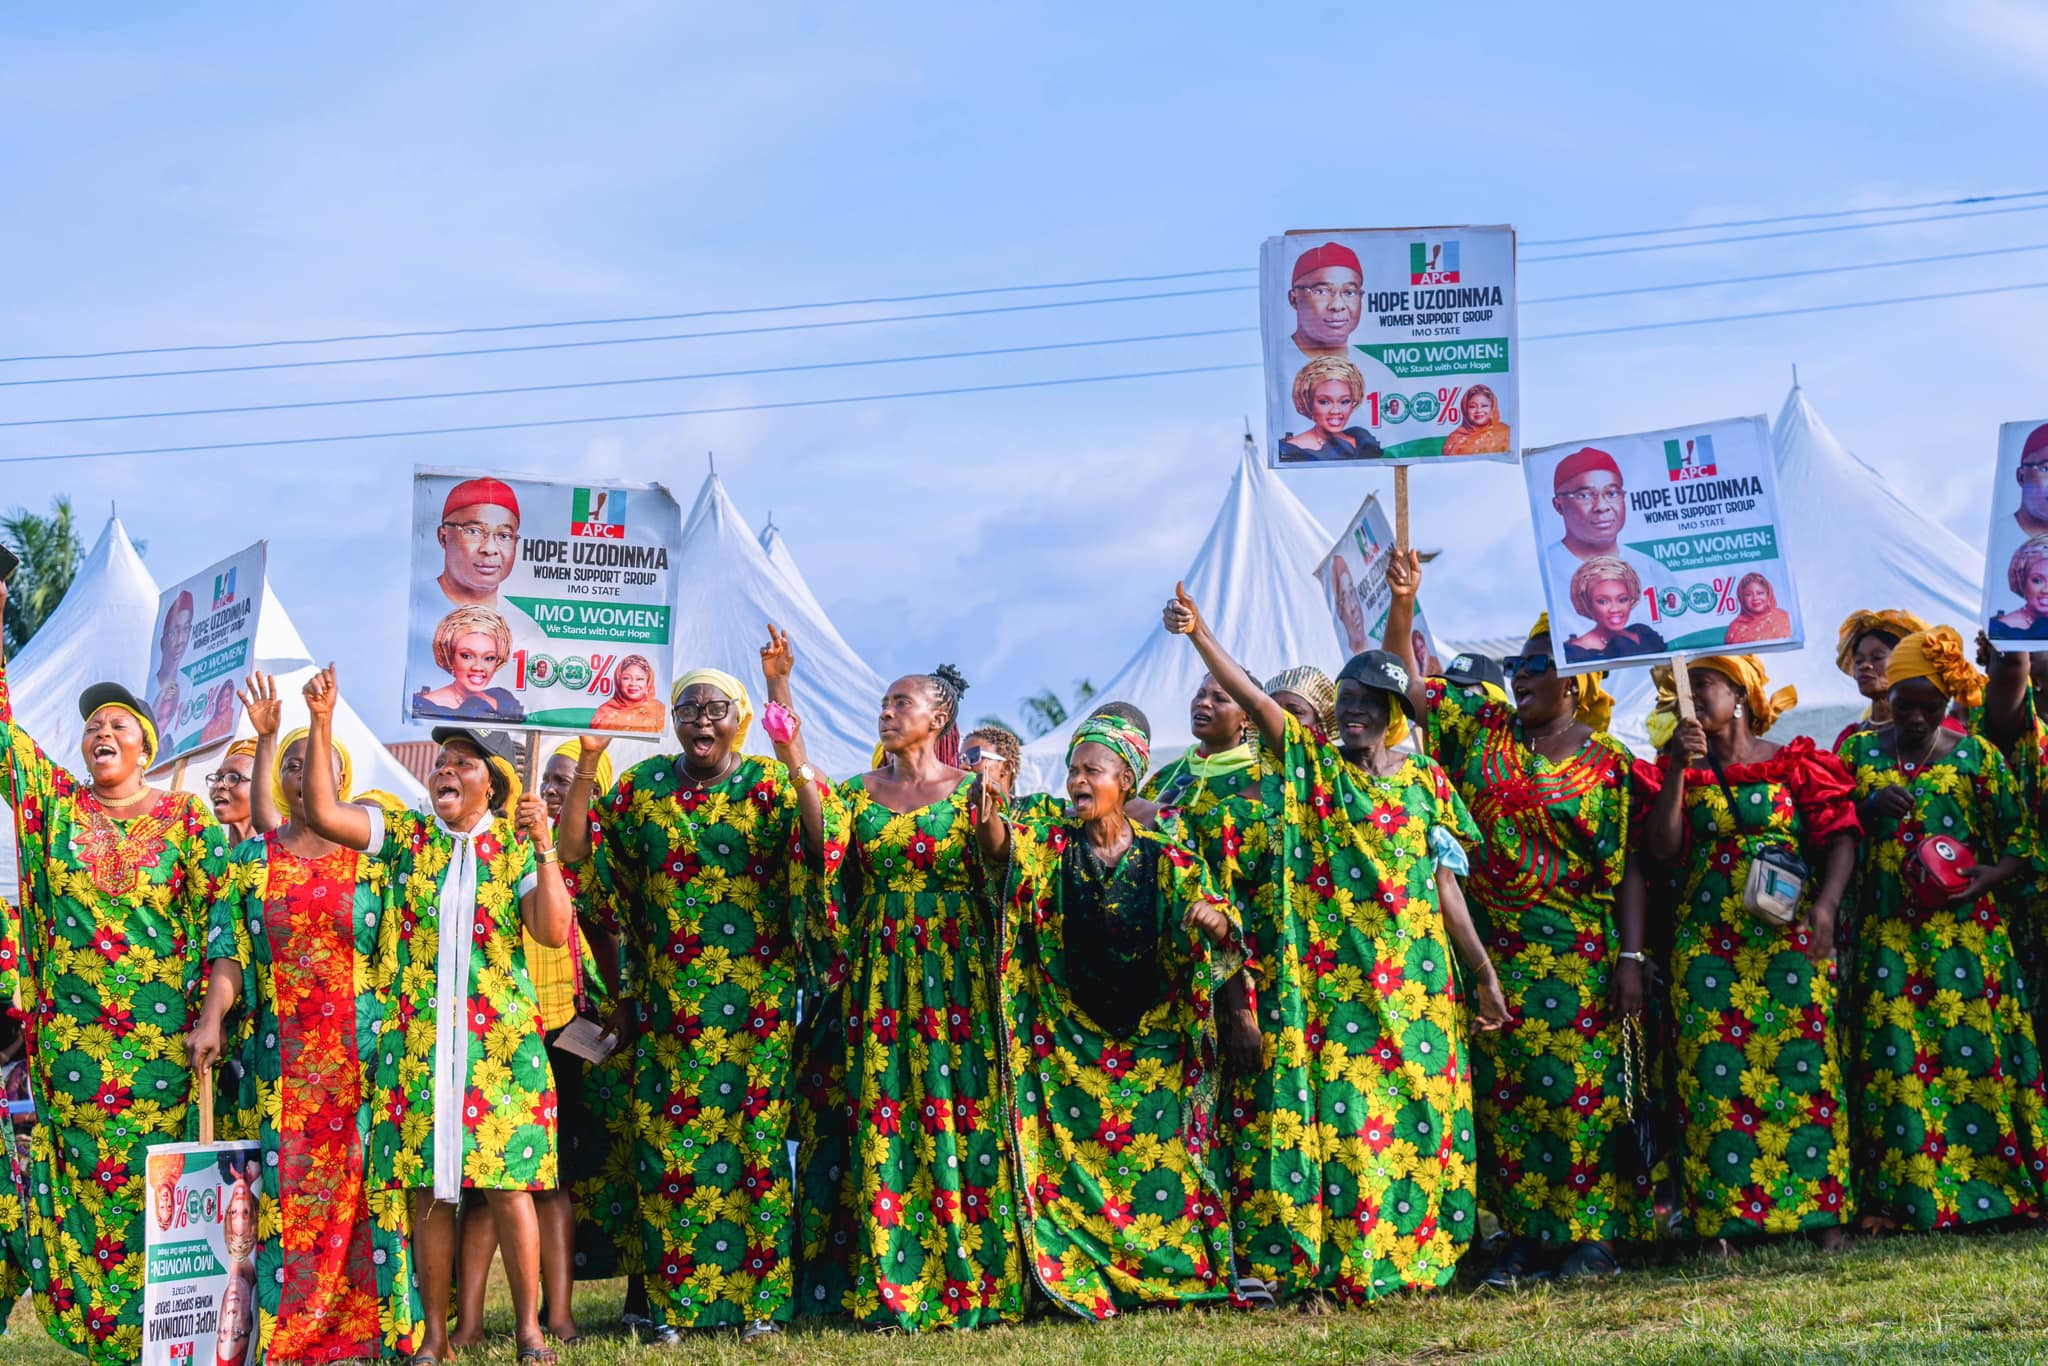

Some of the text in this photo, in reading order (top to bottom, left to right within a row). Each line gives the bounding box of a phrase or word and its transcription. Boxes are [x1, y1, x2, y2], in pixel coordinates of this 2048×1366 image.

[1420, 272, 1452, 285] APC
[1368, 286, 1503, 312] HOPE UZODINMA
[1379, 309, 1493, 327] WOMEN SUPPORT GROUP
[1412, 327, 1460, 336] IMO STATE
[1383, 343, 1503, 364] IMO WOMEN:
[1395, 361, 1491, 374] We Stand with Our Hope
[1367, 387, 1461, 427] 100%
[1679, 466, 1709, 480] APC
[1630, 476, 1763, 511] HOPE UZODINMA
[1645, 499, 1755, 524] WOMEN SUPPORT GROUP
[581, 523, 614, 537] APC
[1678, 518, 1725, 530] IMO STATE
[522, 539, 668, 570] HOPE UZODINMA
[1653, 532, 1772, 558] IMO WOMEN:
[1667, 559, 1681, 568] We
[1682, 556, 1704, 565] Stand
[1705, 554, 1723, 562] with
[1740, 550, 1761, 560] Hope
[534, 565, 656, 585] WOMEN SUPPORT GROUP
[568, 585, 620, 596] IMO STATE
[1643, 577, 1737, 623] 100%
[534, 605, 665, 628] IMO WOMEN:
[546, 625, 650, 639] We Stand with Our Hope
[513, 649, 616, 696] 100%
[175, 1185, 223, 1229] 100%
[151, 1253, 214, 1276] IMO WOMEN:
[172, 1284, 197, 1296] IMO STATE
[155, 1295, 213, 1315] WOMEN SUPPORT GROUP
[149, 1311, 217, 1342] HOPE UZODINMA
[175, 1343, 190, 1357] APC
